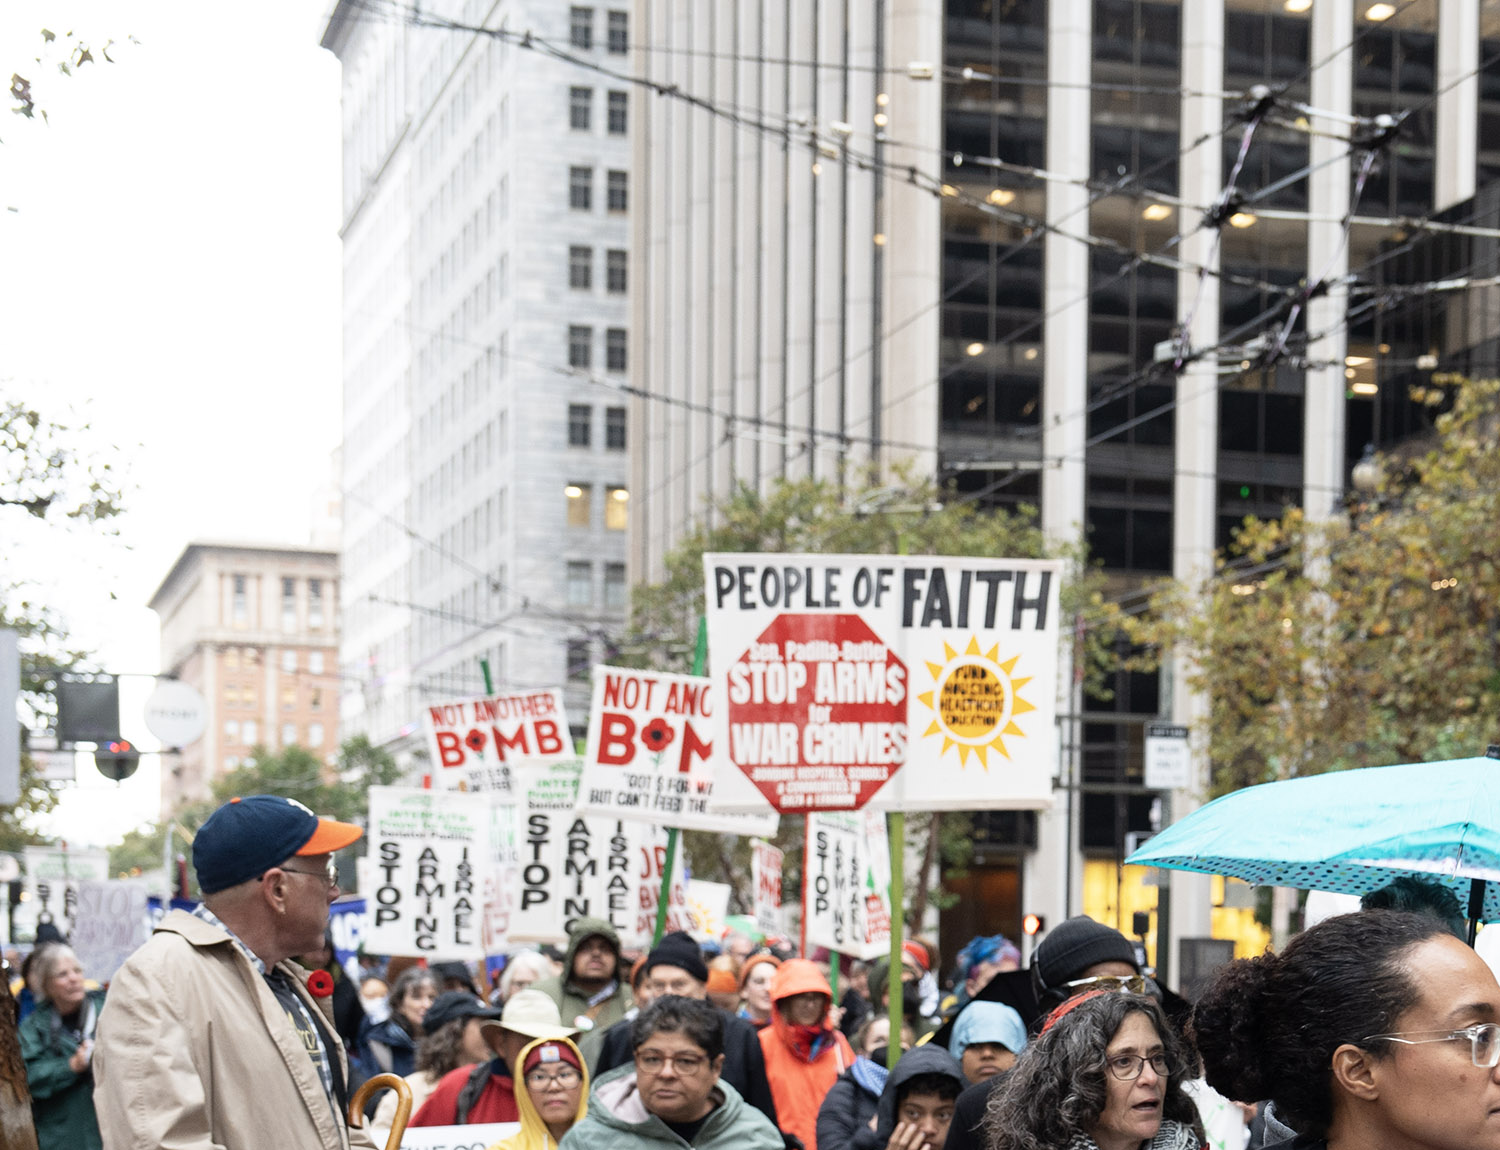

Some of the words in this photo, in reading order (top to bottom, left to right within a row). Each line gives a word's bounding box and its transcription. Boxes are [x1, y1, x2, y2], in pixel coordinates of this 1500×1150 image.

[715, 566, 841, 610] PEOPLE
[852, 567, 894, 608] OF
[902, 567, 1053, 631] FAITH
[729, 661, 807, 705] STOP
[815, 662, 906, 706] ARM$
[749, 642, 784, 661] Sen.
[430, 704, 466, 727] NOT
[474, 692, 556, 721] ANOTHER
[603, 674, 657, 711] NOT
[808, 703, 832, 723] for
[732, 722, 799, 765] WAR
[803, 722, 909, 765] CRIMES
[589, 788, 611, 805] BUT
[617, 791, 650, 808] CAN'T
[654, 794, 683, 813] FEED
[375, 842, 401, 927] STOP
[415, 847, 445, 950] ARMING
[453, 847, 474, 945] ISRAEL
[521, 814, 550, 911] STOP
[607, 820, 629, 930] ISRAEL
[815, 831, 829, 916] STOP
[834, 840, 846, 944] ARMING
[850, 841, 861, 942] ISRAEL
